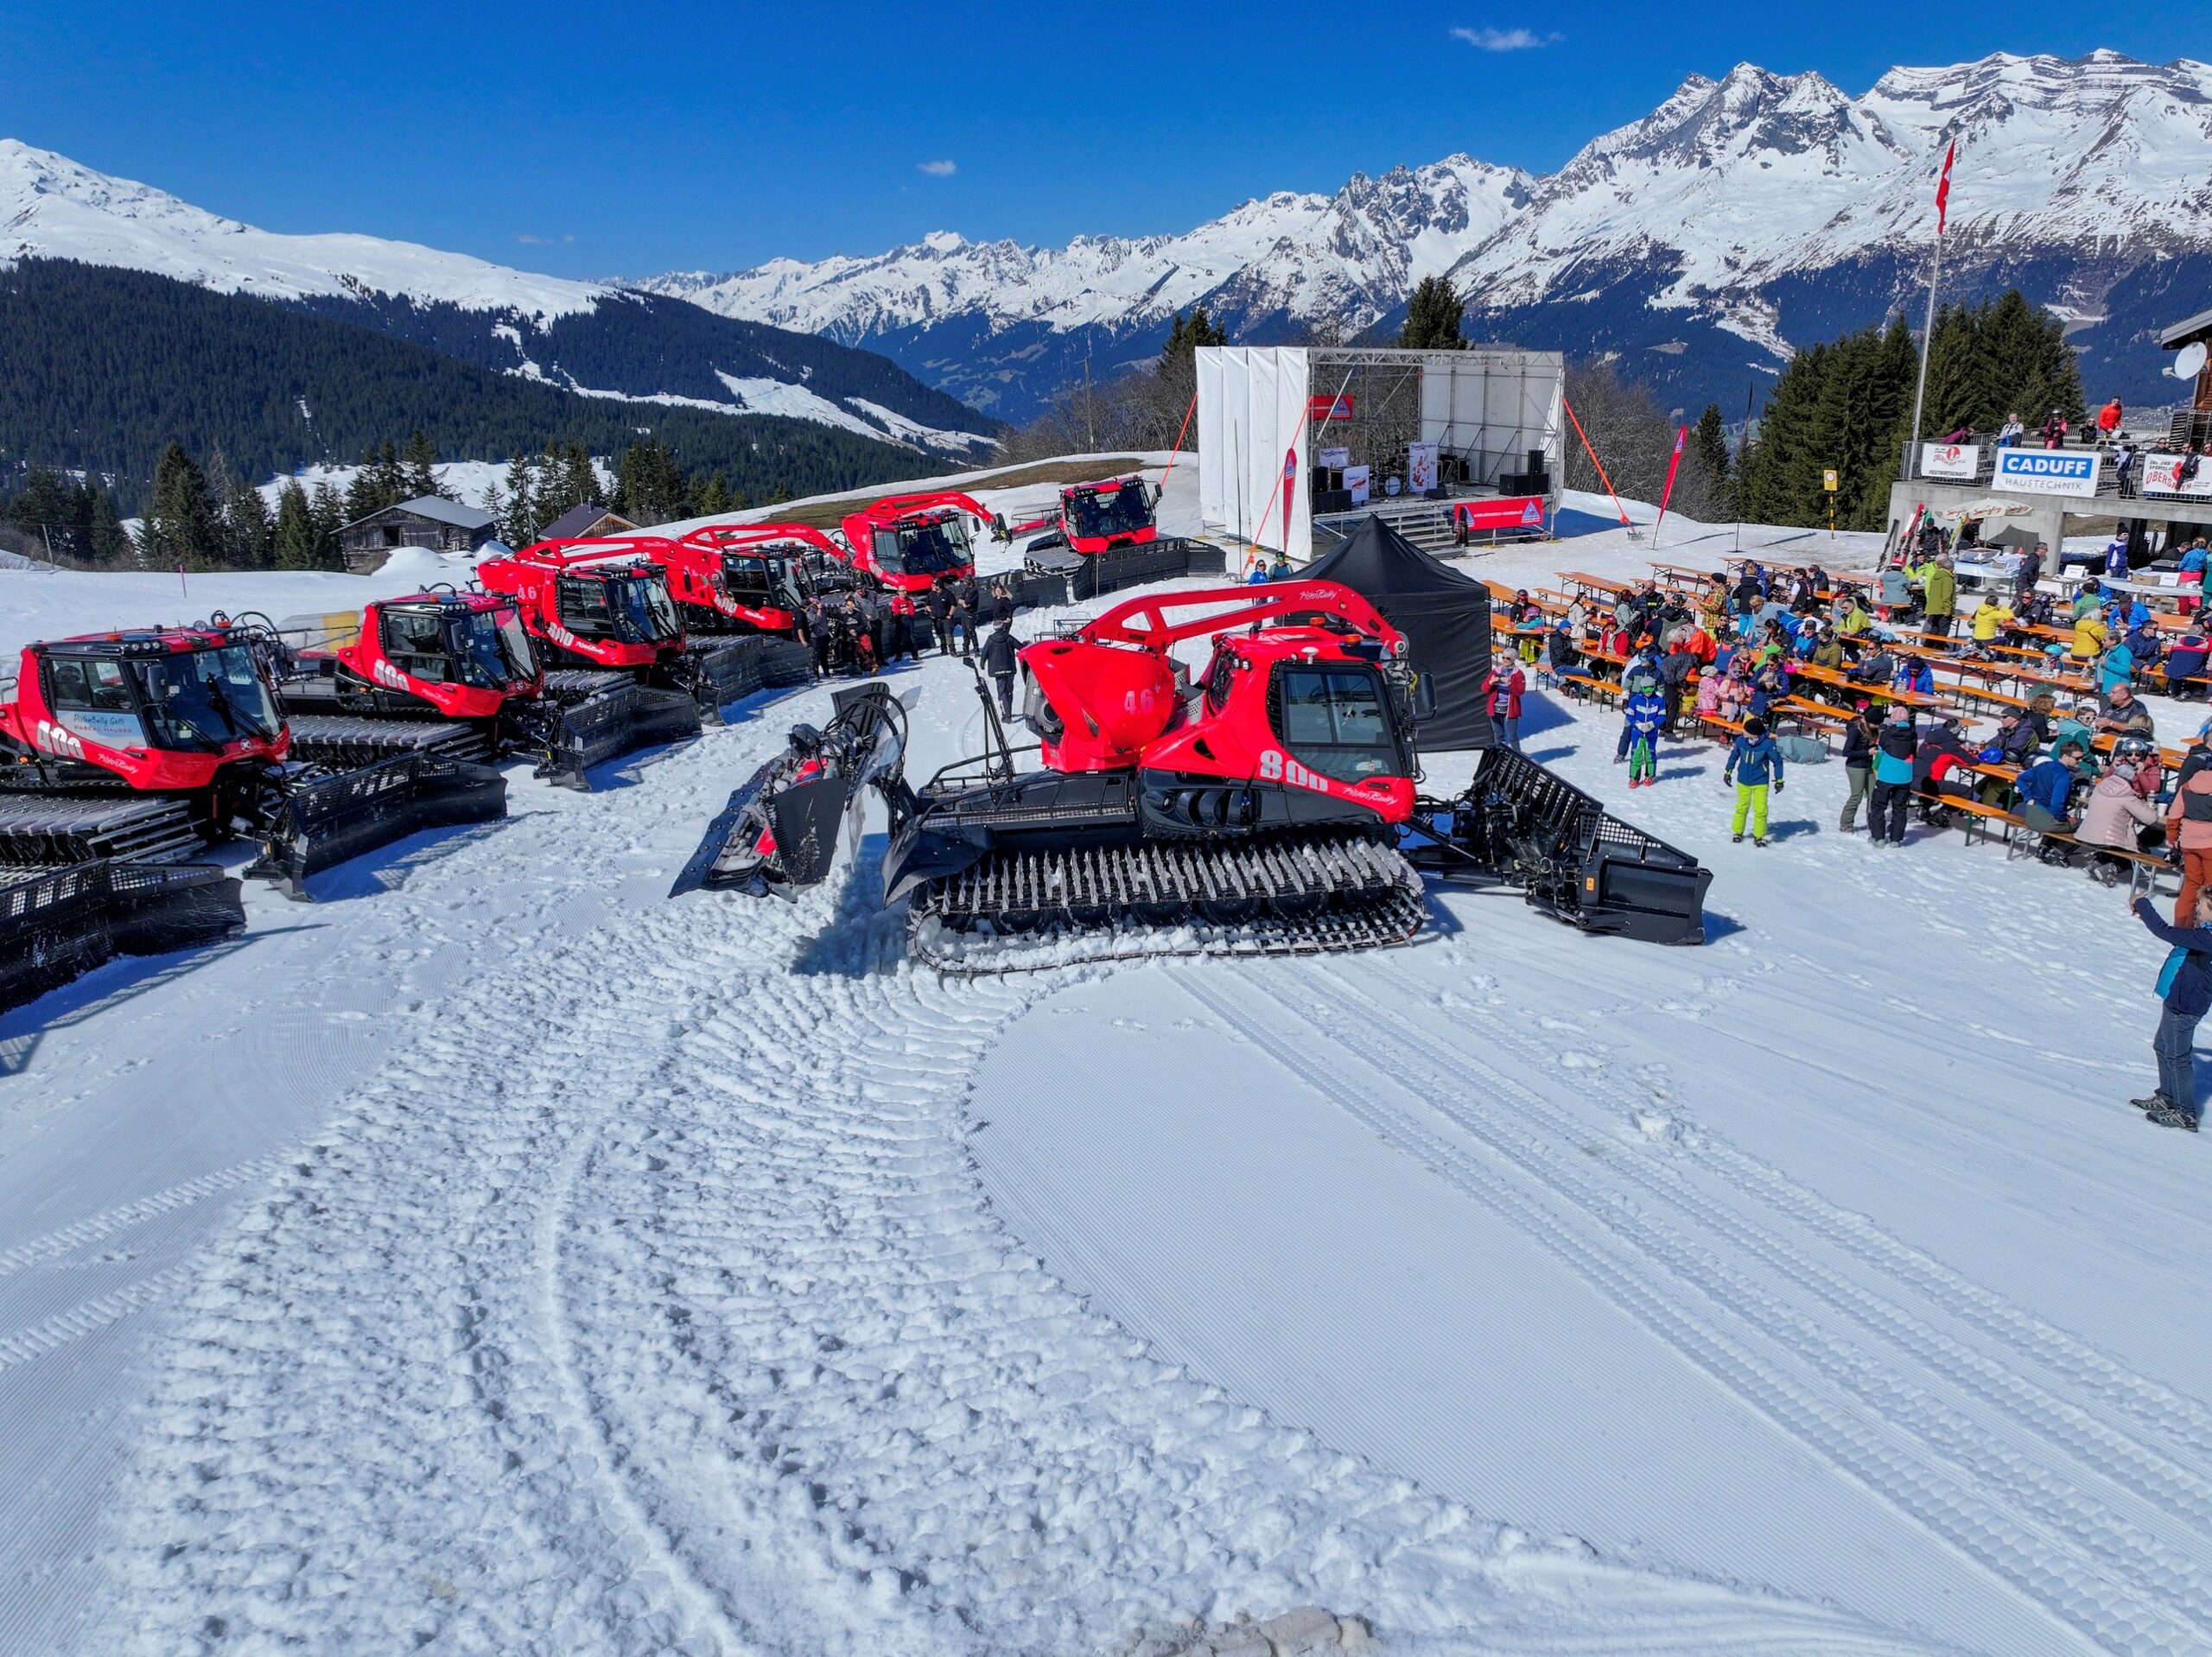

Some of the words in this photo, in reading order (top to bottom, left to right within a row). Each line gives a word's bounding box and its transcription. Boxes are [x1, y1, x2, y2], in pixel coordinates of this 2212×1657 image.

[2006, 457, 2088, 475] CADUFF
[2005, 477, 2082, 491] HAUSTECHNIK
[36, 720, 86, 760] 400
[97, 752, 139, 774] PistenBully
[1259, 749, 1328, 792] 800
[1342, 786, 1398, 806] PistenBully
